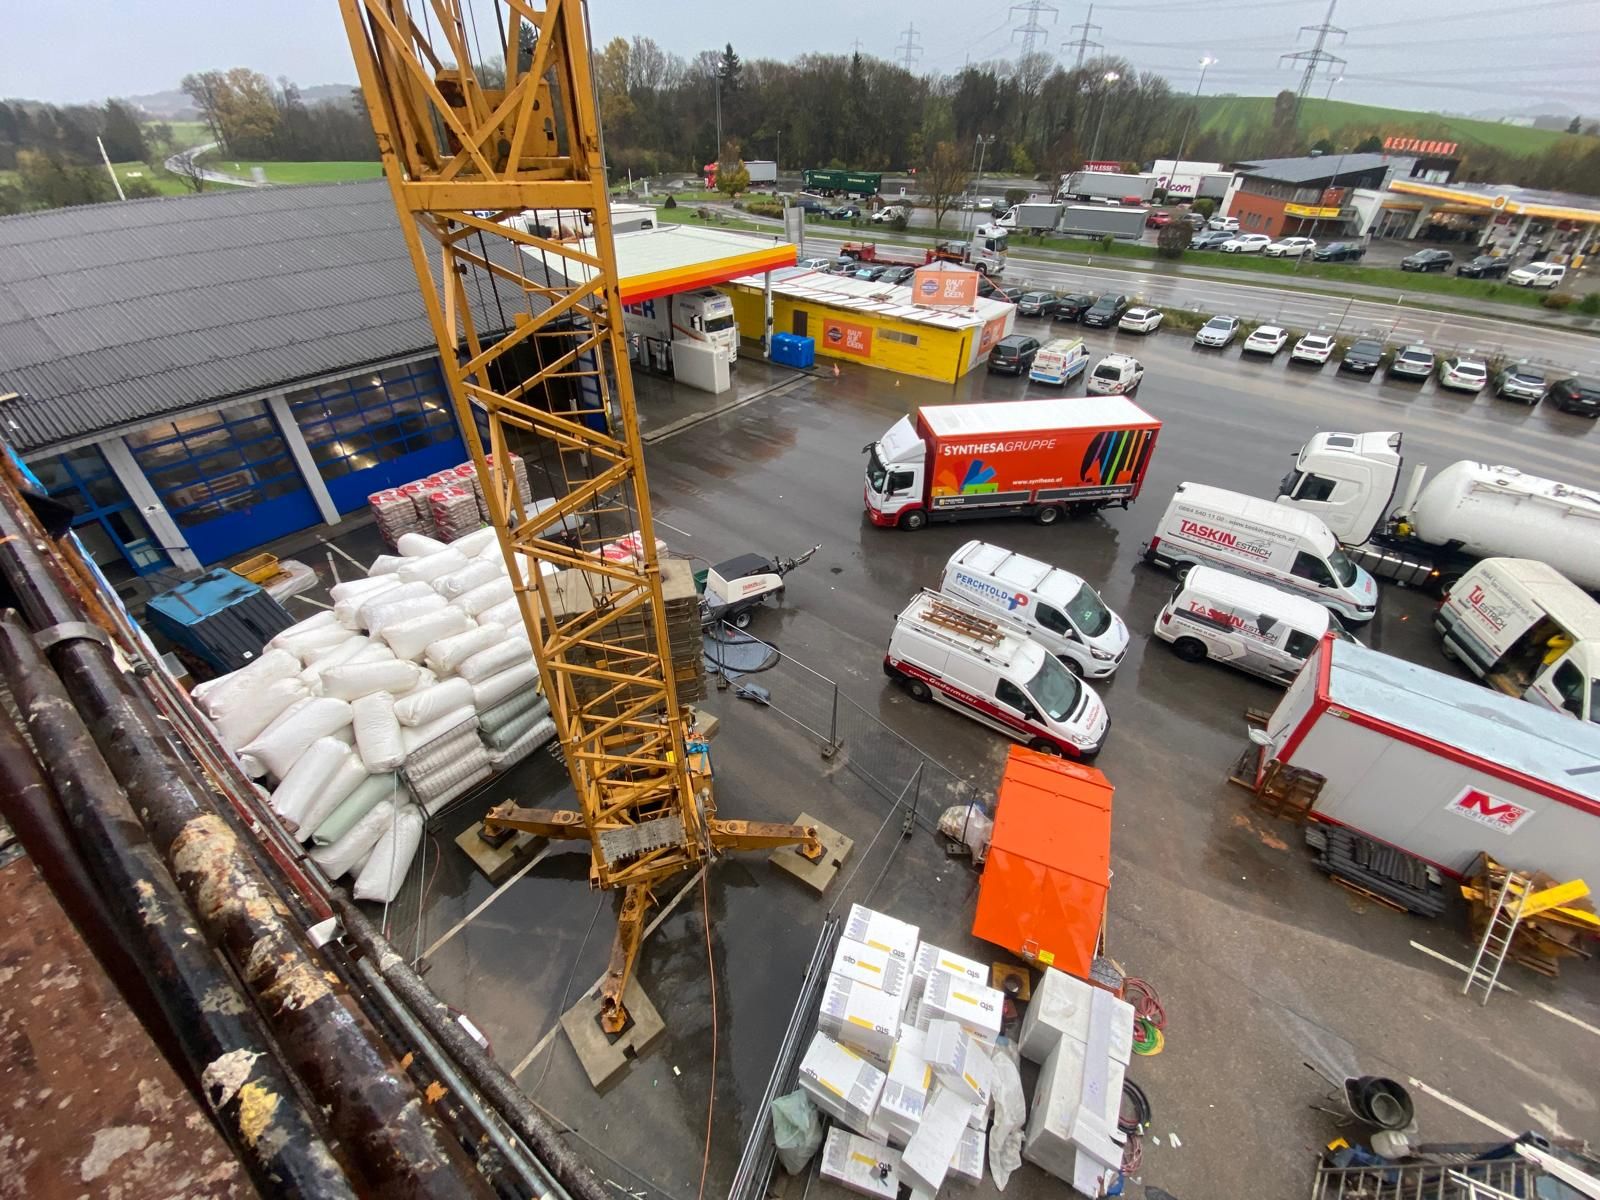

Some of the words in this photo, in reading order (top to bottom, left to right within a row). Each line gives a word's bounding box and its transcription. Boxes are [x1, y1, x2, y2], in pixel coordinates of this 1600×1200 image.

[1384, 136, 1458, 154] RESTAURANT
[1180, 519, 1238, 547] TASKIN
[1235, 541, 1273, 558] ESTRICH
[956, 572, 1008, 600] PERCHTOLD
[892, 948, 906, 959] sto
[843, 955, 856, 965] sto
[966, 969, 981, 979] sto
[980, 1001, 994, 1012] sto
[875, 1024, 889, 1035] sto
